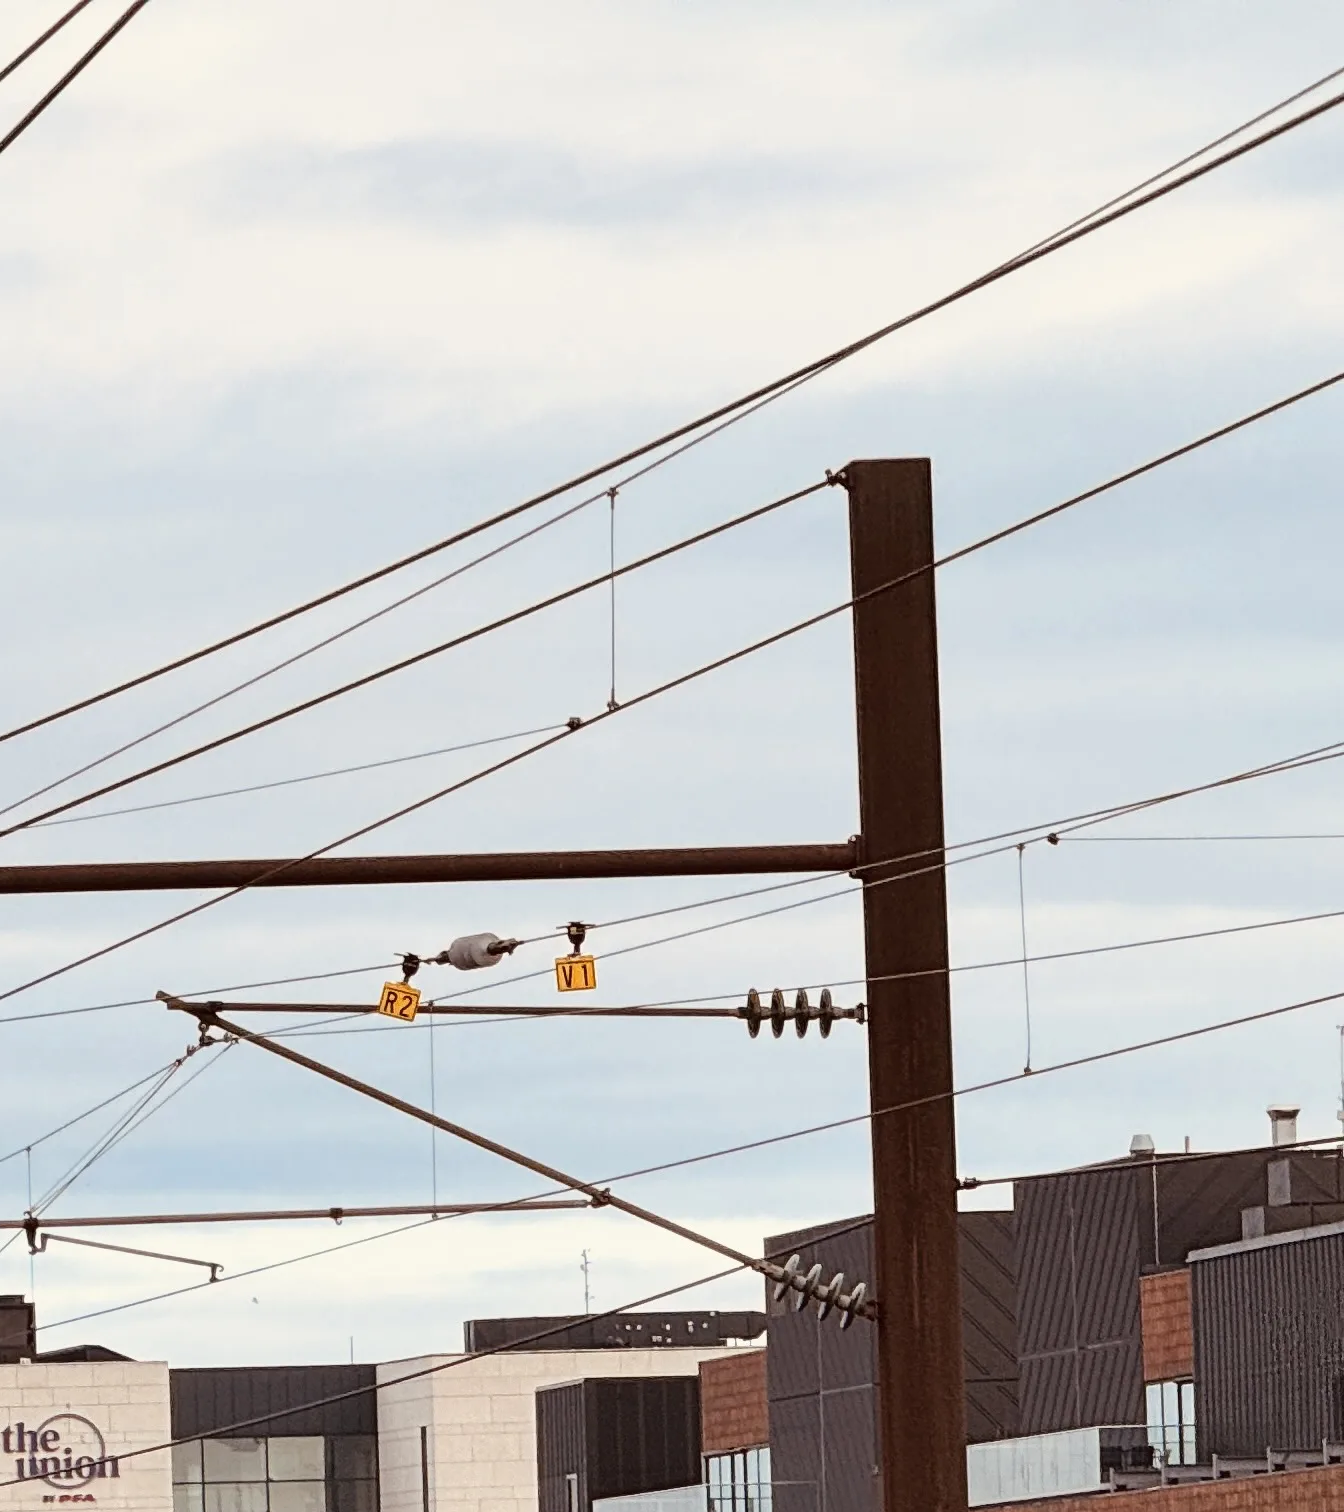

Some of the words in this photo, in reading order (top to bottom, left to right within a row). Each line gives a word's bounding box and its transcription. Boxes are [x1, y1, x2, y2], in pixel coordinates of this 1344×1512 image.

[383, 991, 413, 1018] R2
[0, 1421, 61, 1454] the
[15, 1446, 121, 1481] union
[58, 1494, 96, 1503] PFA
